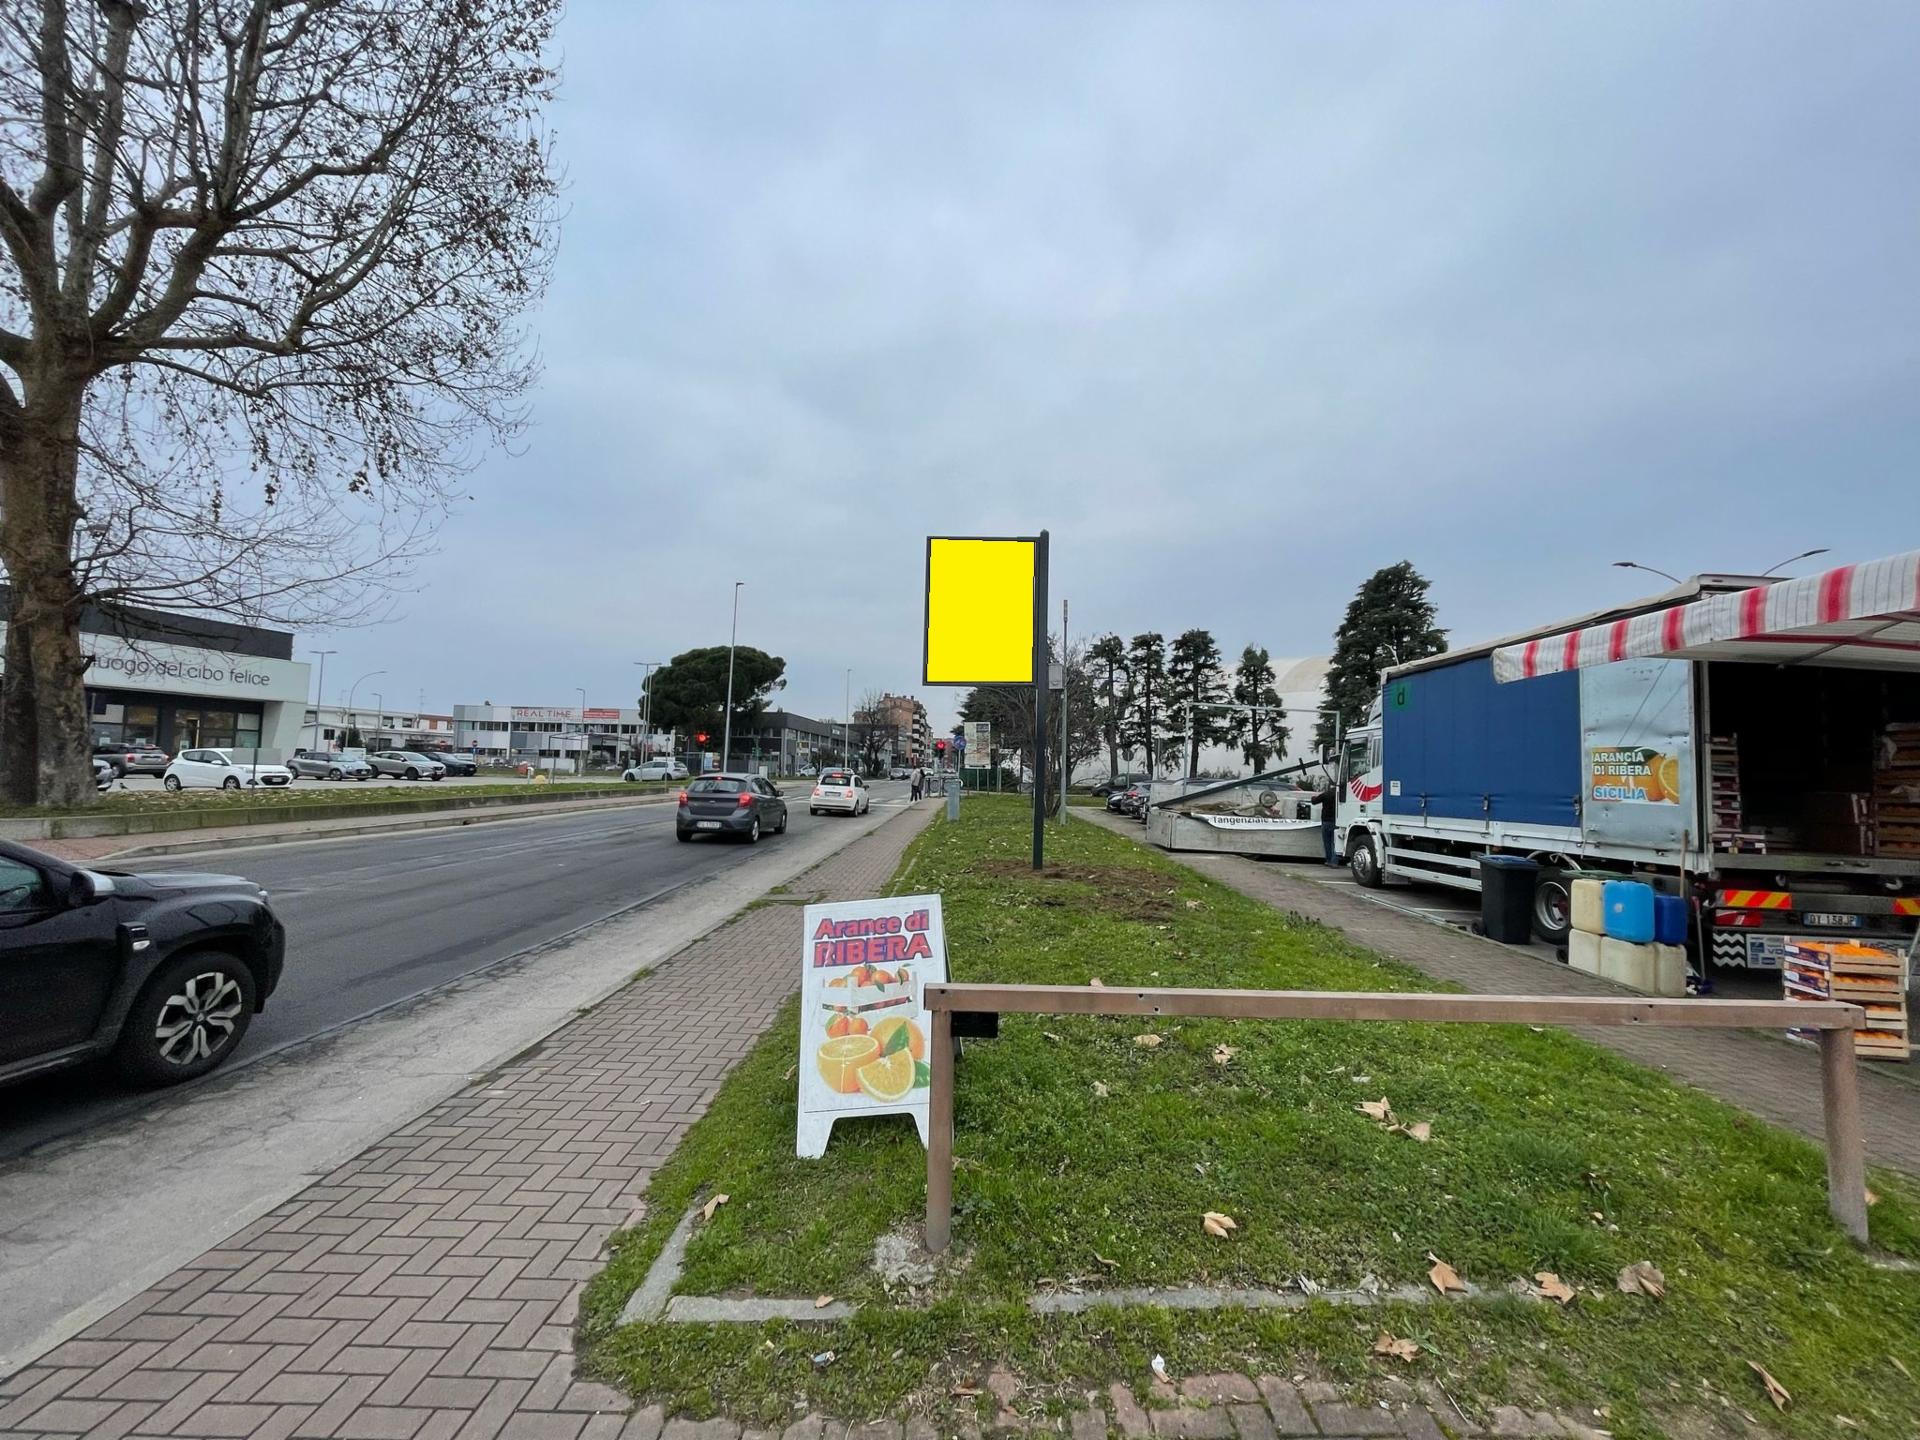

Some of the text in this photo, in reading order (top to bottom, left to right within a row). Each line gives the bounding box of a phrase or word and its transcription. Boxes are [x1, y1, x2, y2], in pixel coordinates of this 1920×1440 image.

[156, 660, 182, 678] del
[187, 664, 223, 681] cibo
[230, 668, 270, 686] felice
[517, 709, 571, 718] REAL TIME
[1593, 752, 1645, 762] ARANCIA
[1594, 765, 1652, 776] DI RIBERA
[1594, 786, 1647, 801] SICILIA
[813, 909, 930, 940] Arance di
[813, 933, 933, 968] RIBERA
